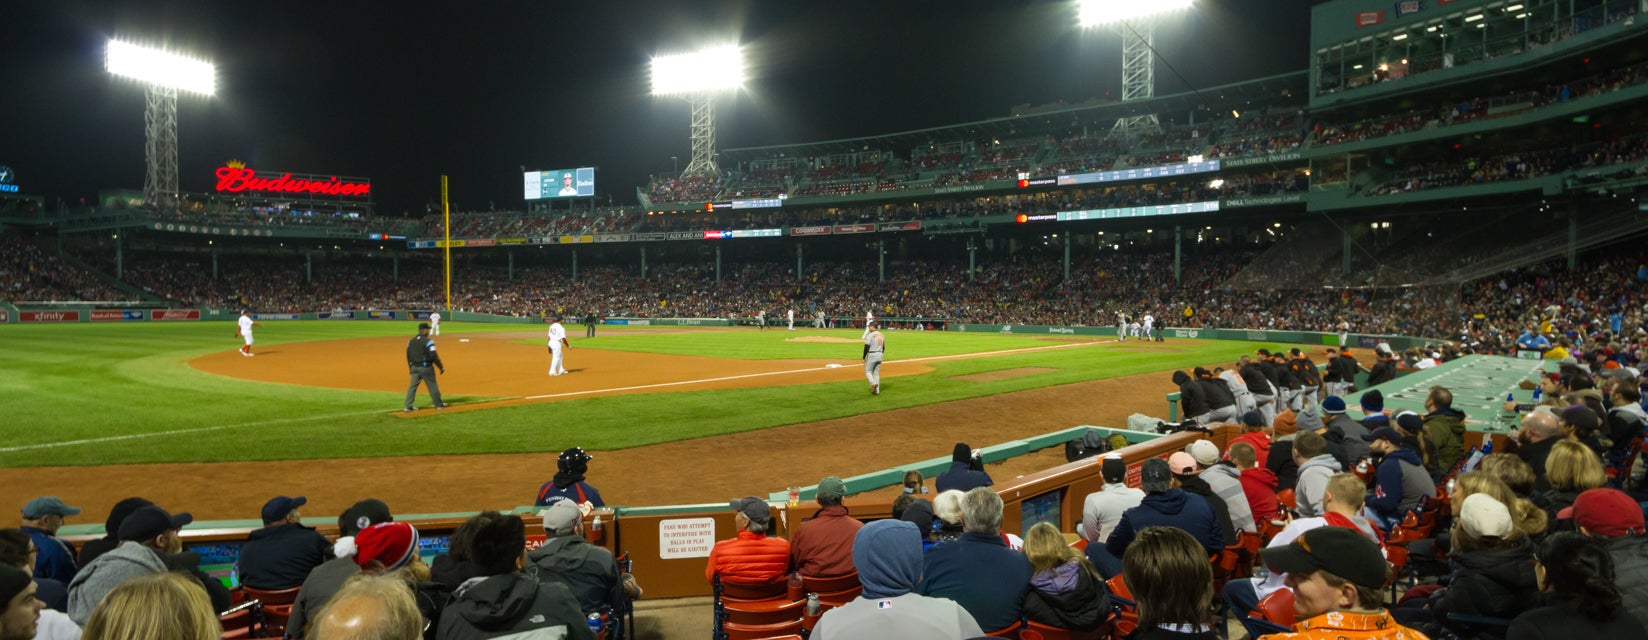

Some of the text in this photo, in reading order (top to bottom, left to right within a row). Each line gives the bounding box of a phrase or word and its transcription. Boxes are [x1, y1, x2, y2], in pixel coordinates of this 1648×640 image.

[1268, 152, 1300, 162] PAVILION
[215, 167, 371, 196] Budweiser
[1027, 213, 1057, 221] masterpass
[34, 312, 65, 322] xfinity
